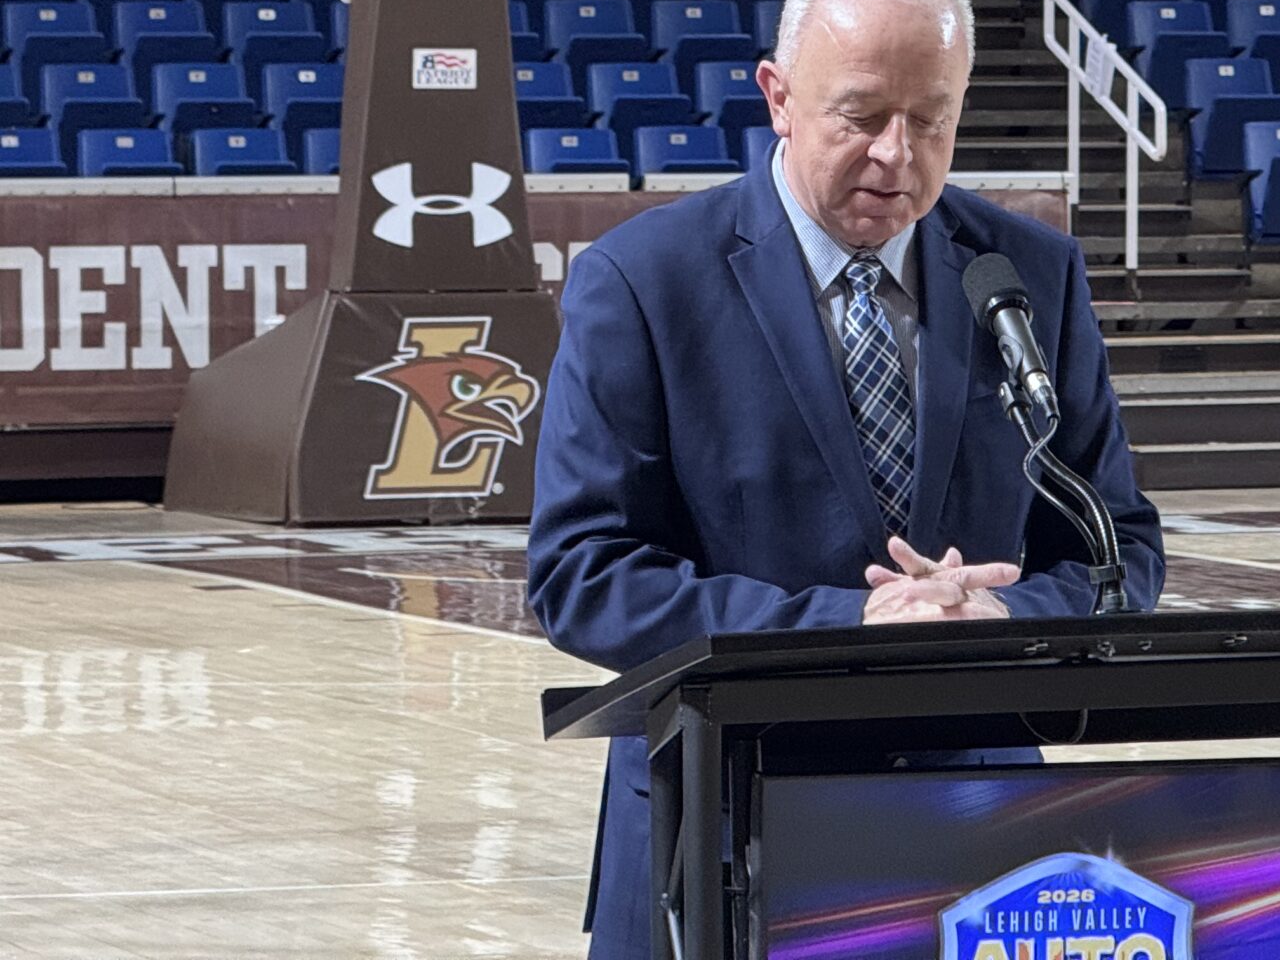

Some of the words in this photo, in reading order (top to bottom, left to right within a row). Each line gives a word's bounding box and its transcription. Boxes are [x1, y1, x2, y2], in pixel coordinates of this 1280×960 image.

[1037, 888, 1096, 904] 2026
[984, 908, 1059, 933] LEHIGH
[1072, 906, 1148, 931] VALLEY
